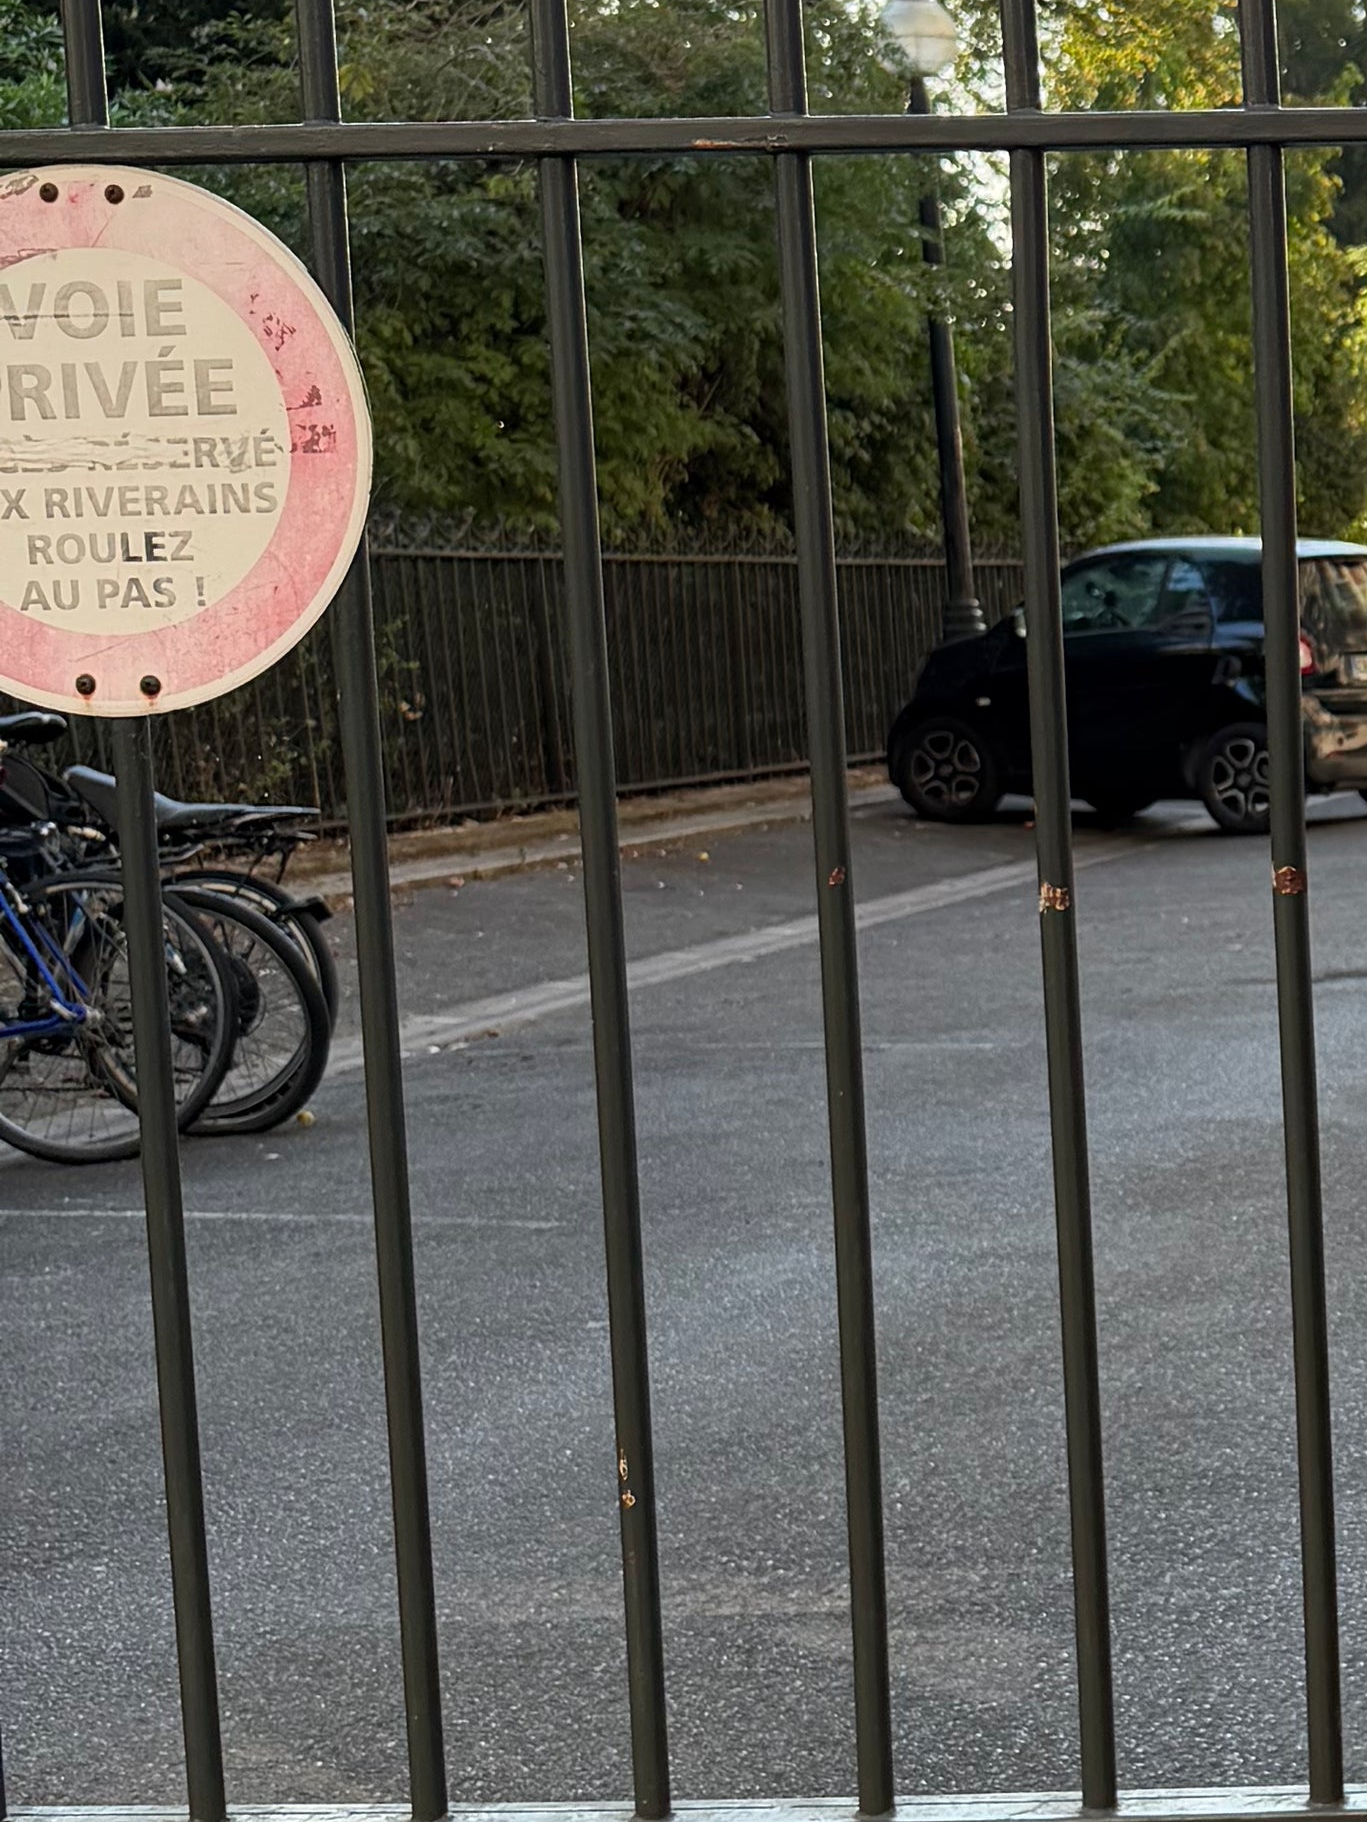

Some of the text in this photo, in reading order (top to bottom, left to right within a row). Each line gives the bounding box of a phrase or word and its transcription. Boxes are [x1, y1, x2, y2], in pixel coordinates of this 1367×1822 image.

[0, 278, 188, 340] VOIE
[0, 345, 238, 421] RIVÉE
[44, 481, 279, 519] RIVERAINS
[27, 530, 195, 565] ROULEZ
[20, 579, 81, 612] AU
[97, 576, 177, 610] PAS
